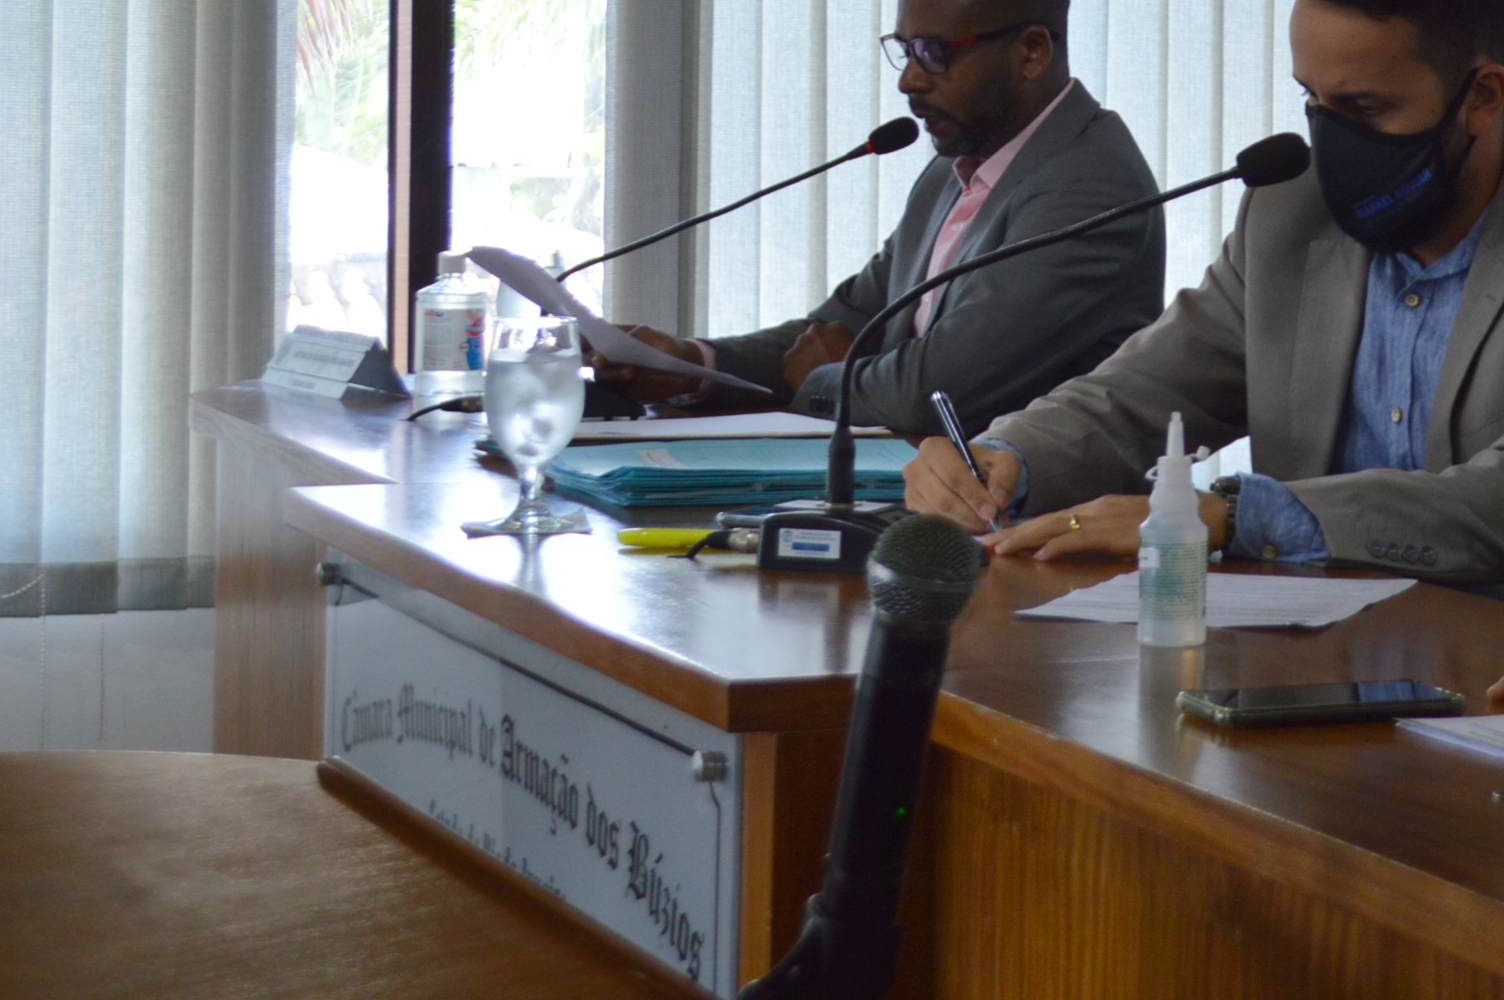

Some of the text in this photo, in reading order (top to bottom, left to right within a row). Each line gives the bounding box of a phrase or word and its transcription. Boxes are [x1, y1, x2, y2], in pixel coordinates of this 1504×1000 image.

[479, 704, 495, 768] de
[501, 713, 579, 836] Armação
[586, 781, 620, 871] dos
[626, 820, 704, 982] Búzios
